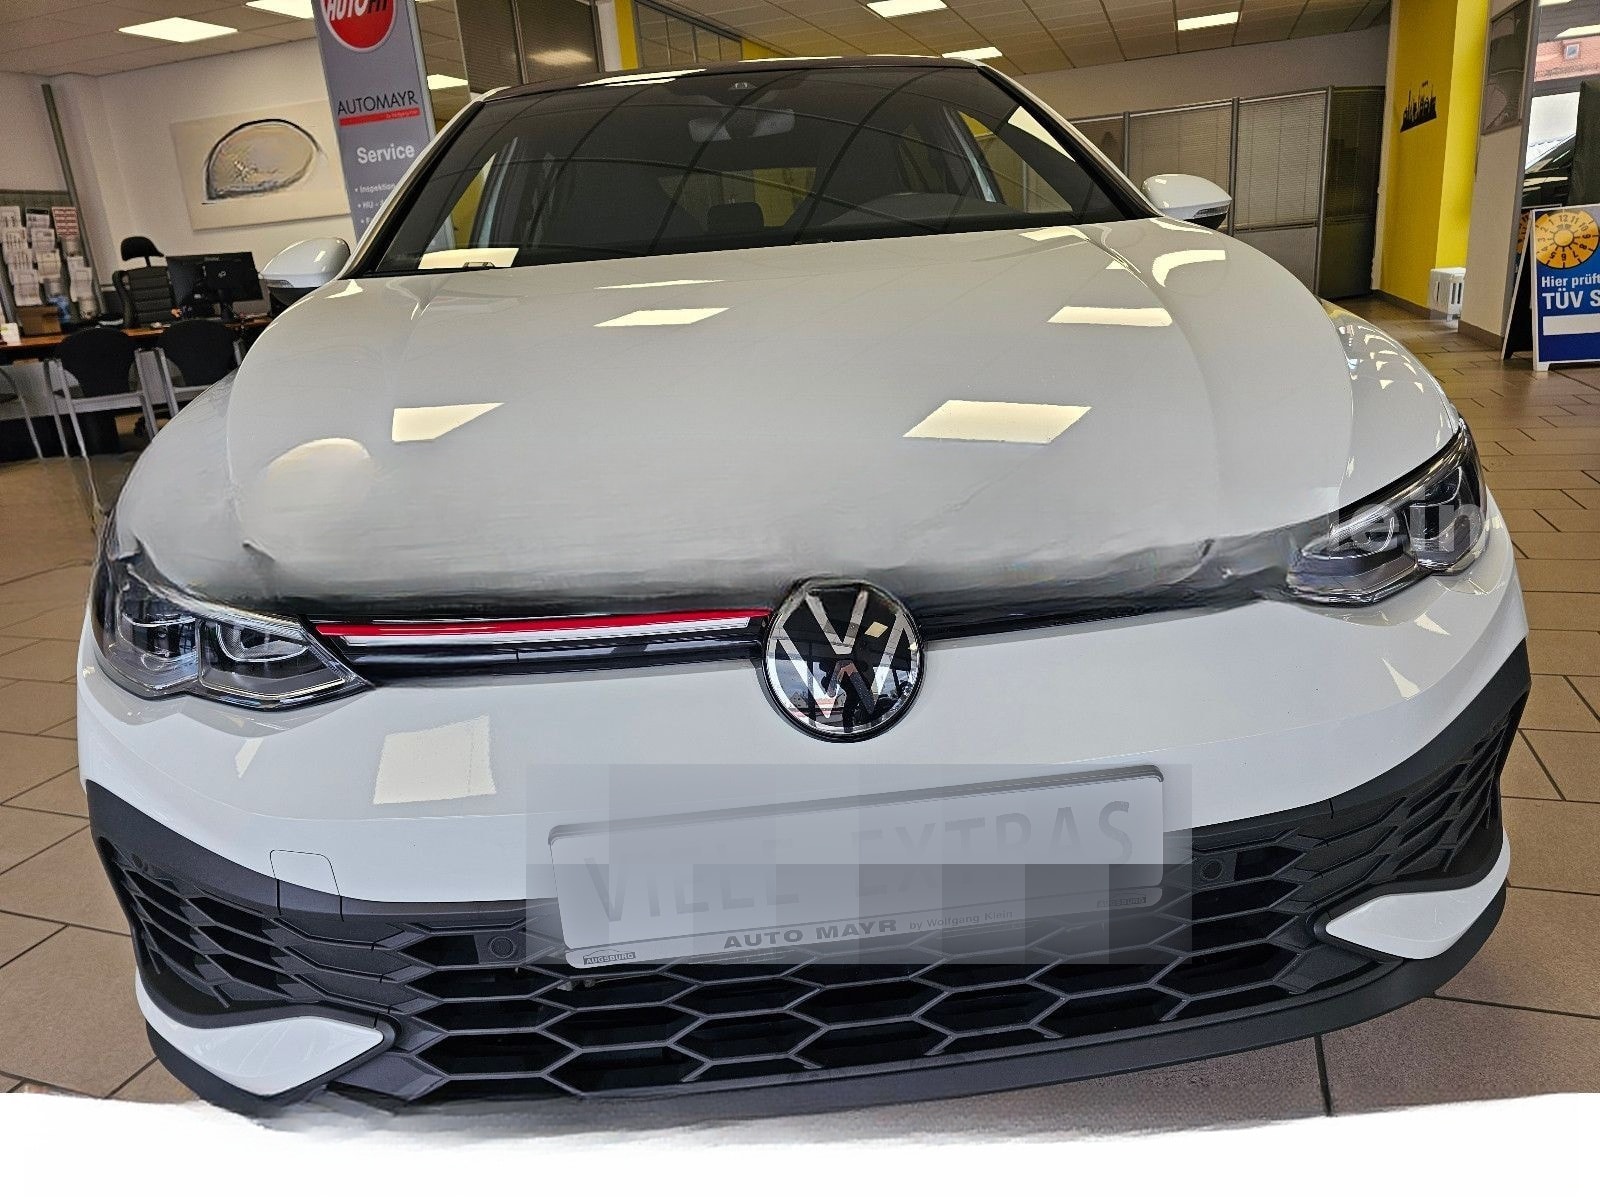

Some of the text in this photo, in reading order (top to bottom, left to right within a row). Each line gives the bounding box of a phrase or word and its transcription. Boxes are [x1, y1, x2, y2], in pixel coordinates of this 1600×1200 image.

[337, 90, 419, 115] AUTOMAYR
[356, 143, 415, 164] Service
[1541, 276, 1568, 288] Hier
[1542, 287, 1584, 310] TÜV
[723, 910, 1013, 949] AUTO MAYR by Wolfgang Klein
